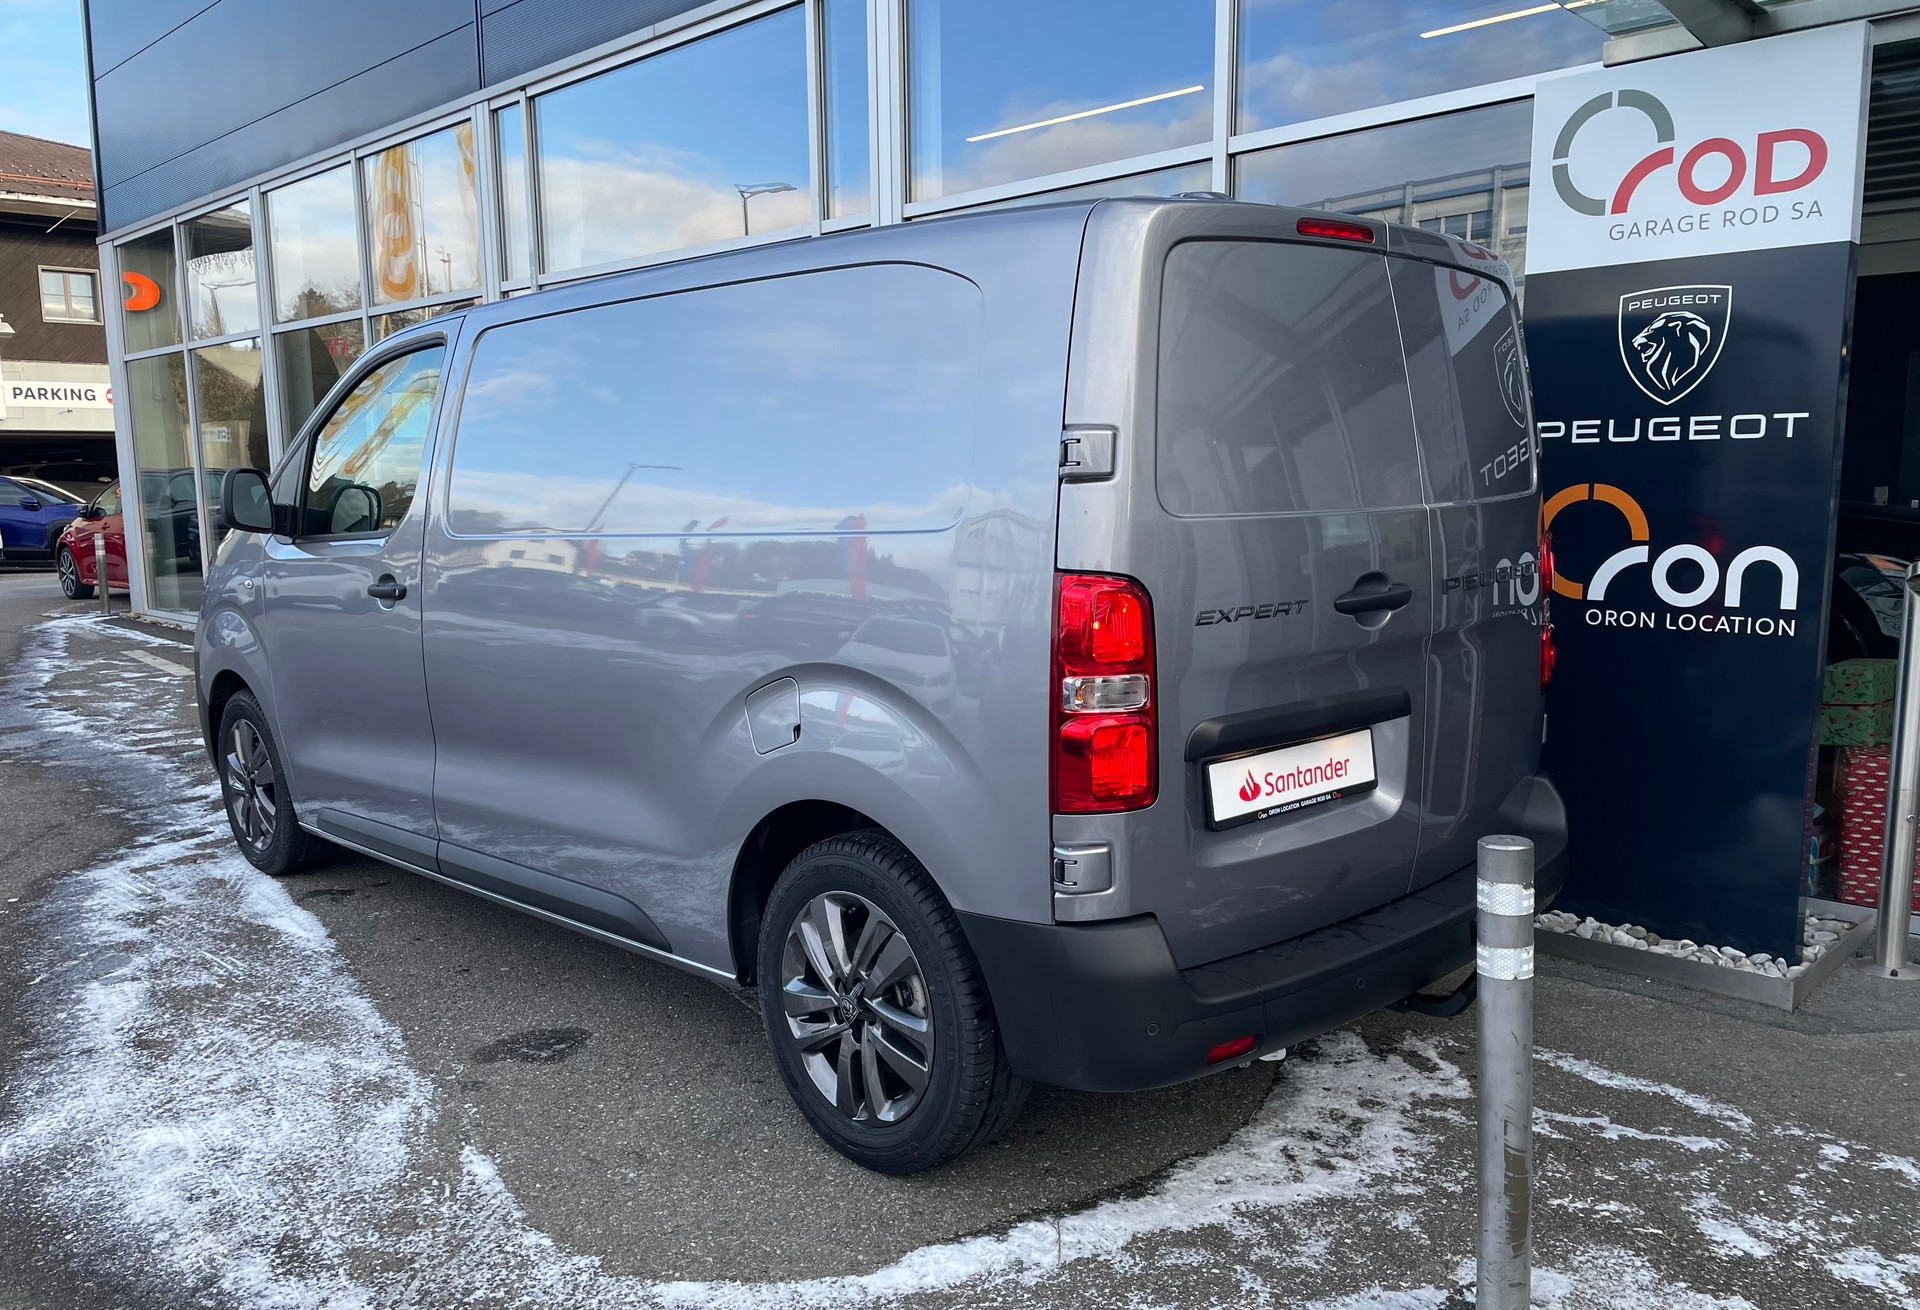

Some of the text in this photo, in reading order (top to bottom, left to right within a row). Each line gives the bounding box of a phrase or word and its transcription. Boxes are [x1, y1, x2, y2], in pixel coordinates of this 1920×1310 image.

[1609, 200, 1823, 241] GARAGE ROD SA
[1628, 294, 1722, 311] PEUGEOT
[12, 387, 97, 401] PARKING
[1537, 412, 1809, 443] PEUGEOT
[1442, 560, 1541, 595] PEUGEOT
[1194, 600, 1309, 626] EXPERT
[1586, 609, 1796, 637] ORON LOCATION
[1264, 758, 1350, 796] Santander
[1280, 802, 1300, 813] LOCATION
[1300, 797, 1317, 807] GARAGE
